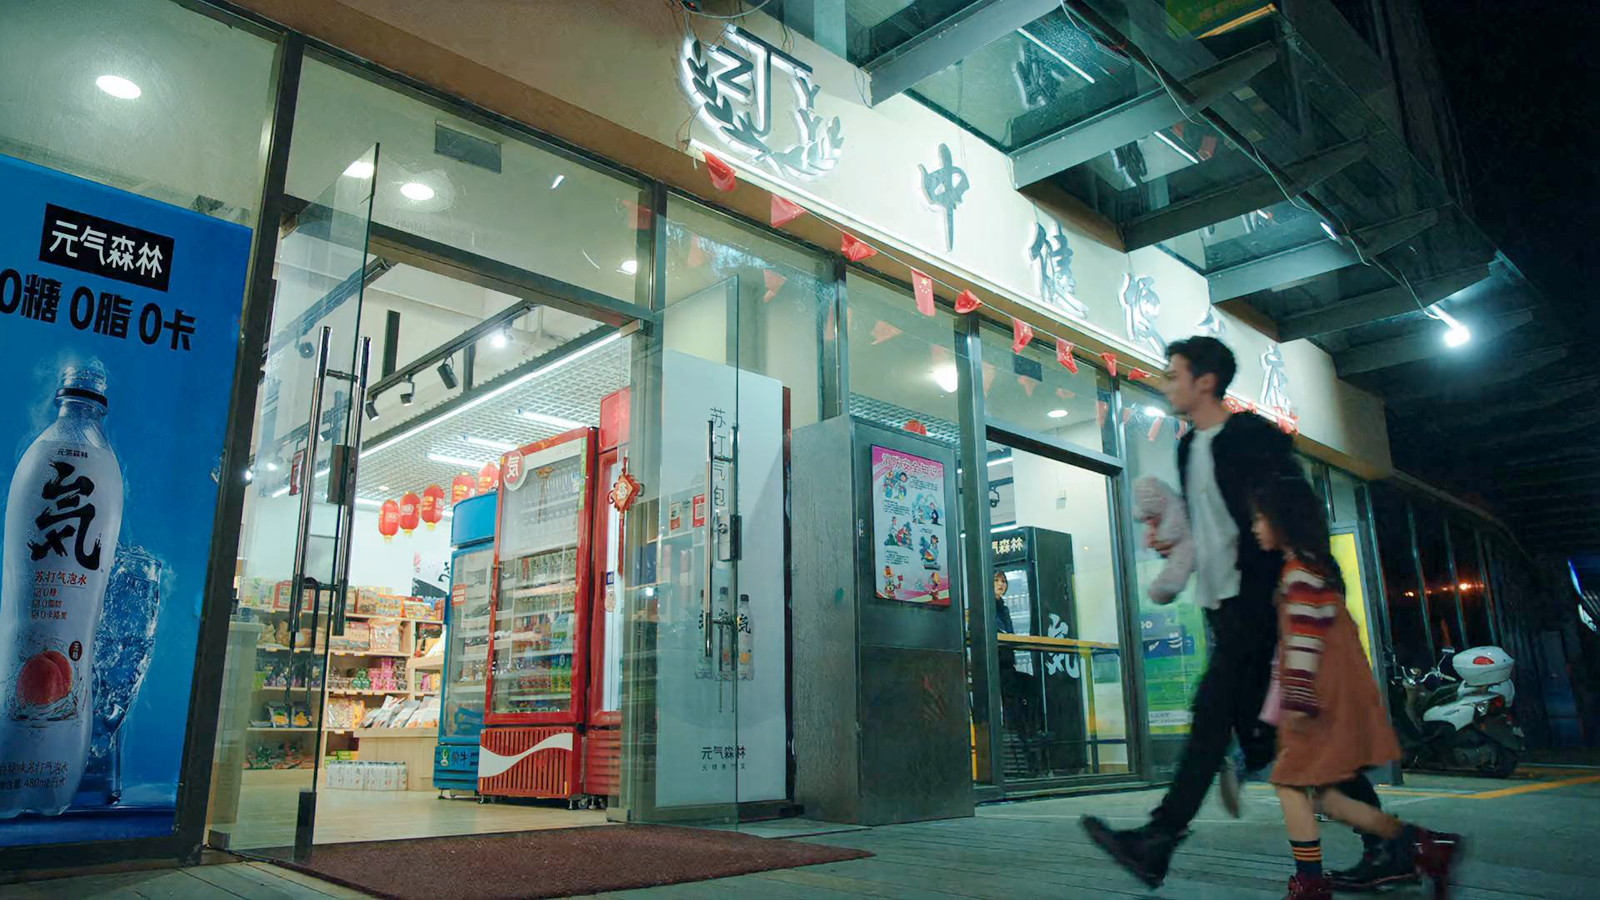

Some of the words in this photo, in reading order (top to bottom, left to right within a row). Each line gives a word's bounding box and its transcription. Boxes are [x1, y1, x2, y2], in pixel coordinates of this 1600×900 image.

[49, 219, 164, 279] 元气森林
[0, 268, 62, 324] 0糖
[70, 286, 134, 339] 0脂
[139, 303, 197, 351] 0卡
[35, 571, 87, 586] 苏打气泡水
[701, 745, 746, 760] 元气森林
